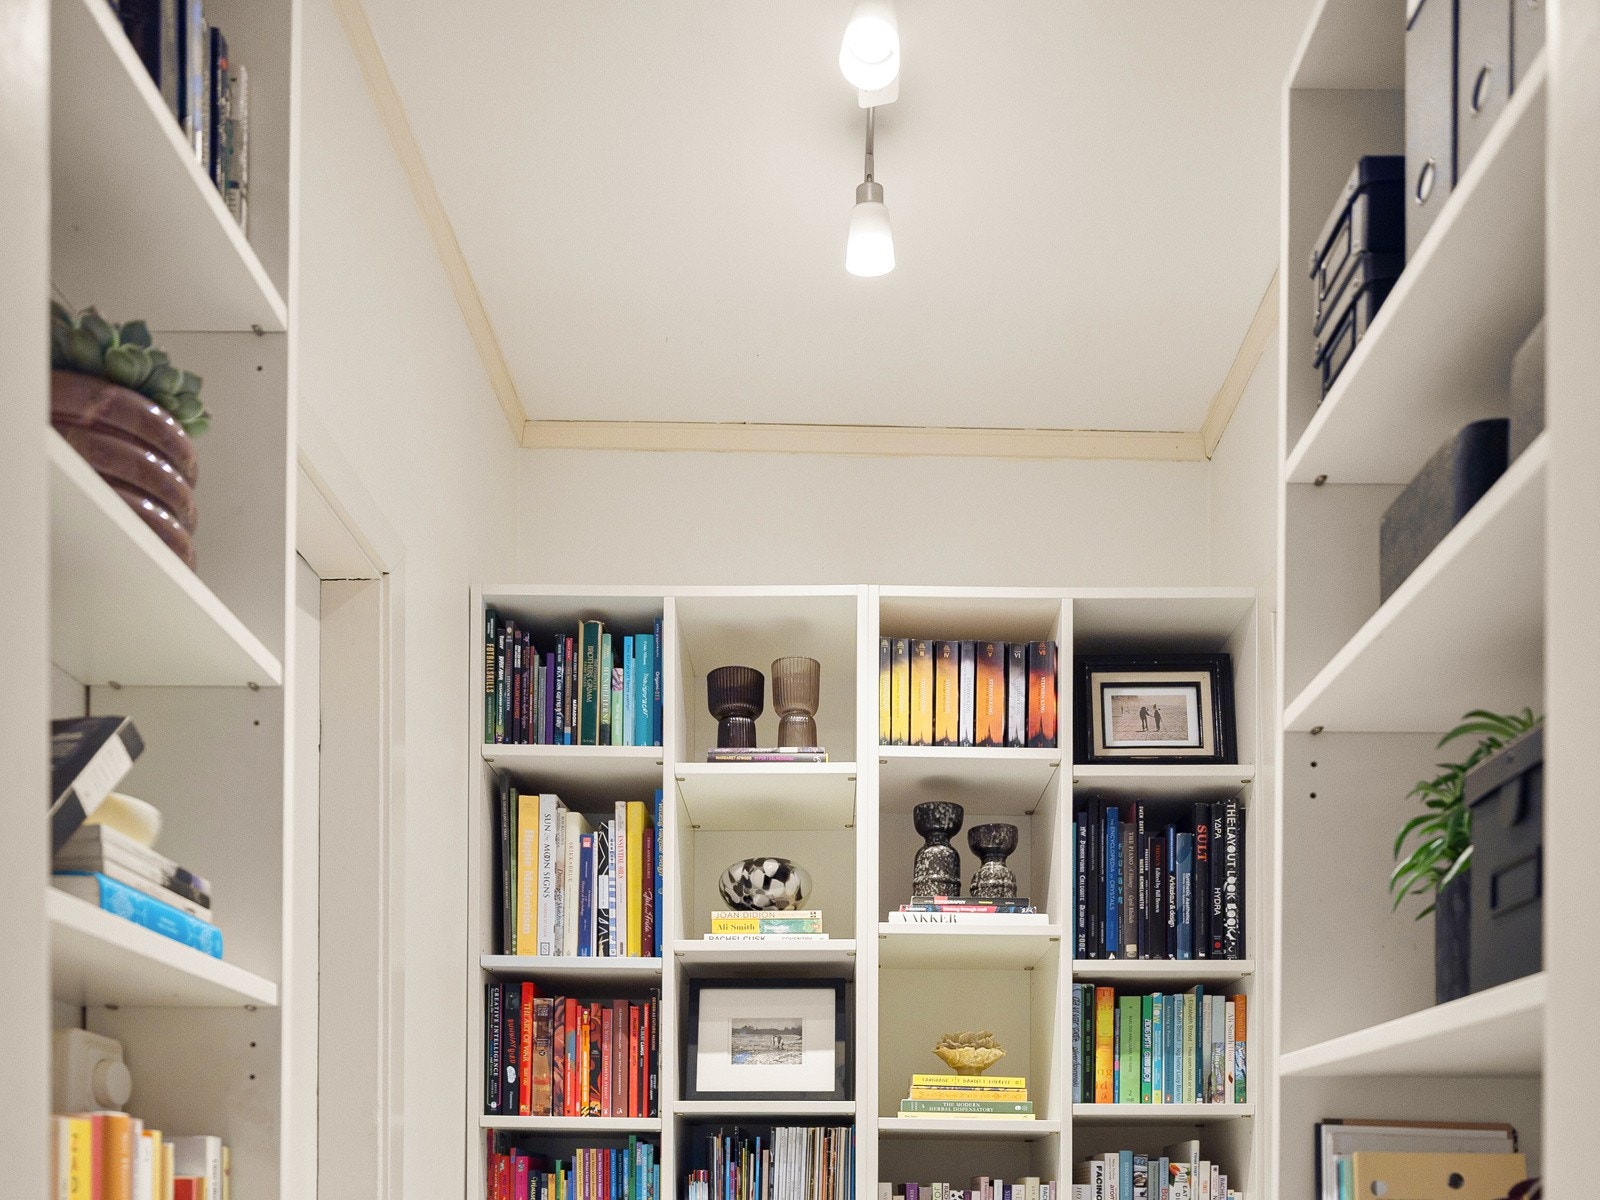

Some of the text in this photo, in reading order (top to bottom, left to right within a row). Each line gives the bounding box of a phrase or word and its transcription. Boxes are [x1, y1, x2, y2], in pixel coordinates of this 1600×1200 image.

[1227, 803, 1236, 823] THE
[1197, 825, 1207, 862] SULT
[1227, 827, 1236, 867] LAYOUT
[543, 872, 551, 898] SIGNS
[1227, 870, 1236, 900] LOOK
[523, 1034, 530, 1043] OF
